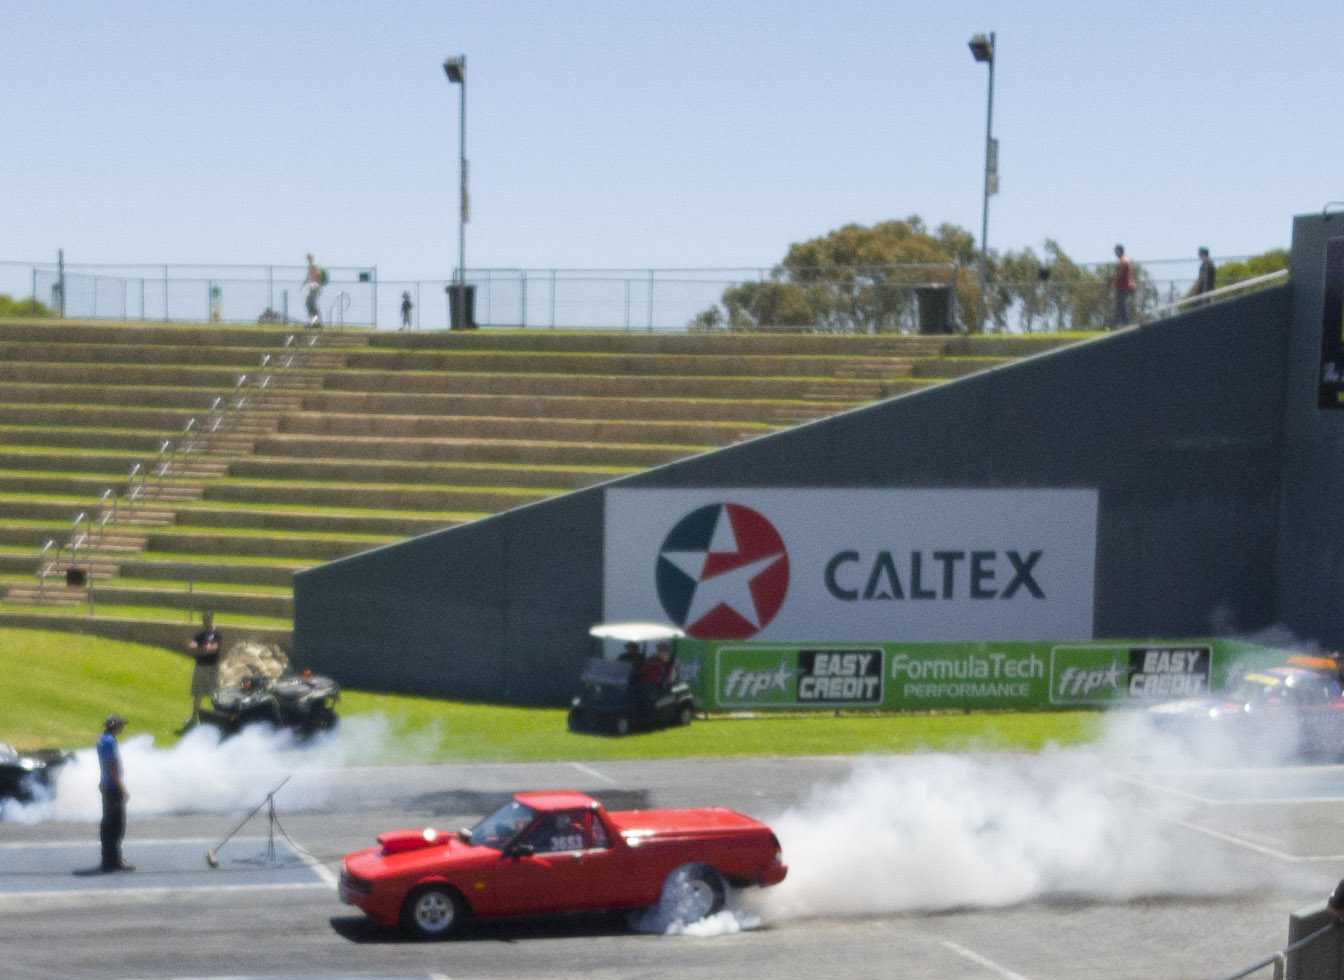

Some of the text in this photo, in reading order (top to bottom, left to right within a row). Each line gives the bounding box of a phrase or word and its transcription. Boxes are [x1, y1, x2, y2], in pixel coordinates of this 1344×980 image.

[824, 549, 1048, 602] CALTEX
[813, 653, 873, 677] EASY
[1142, 651, 1201, 674] EASY
[799, 676, 881, 699] CREDIT
[904, 683, 1031, 698] PERFORMANCE
